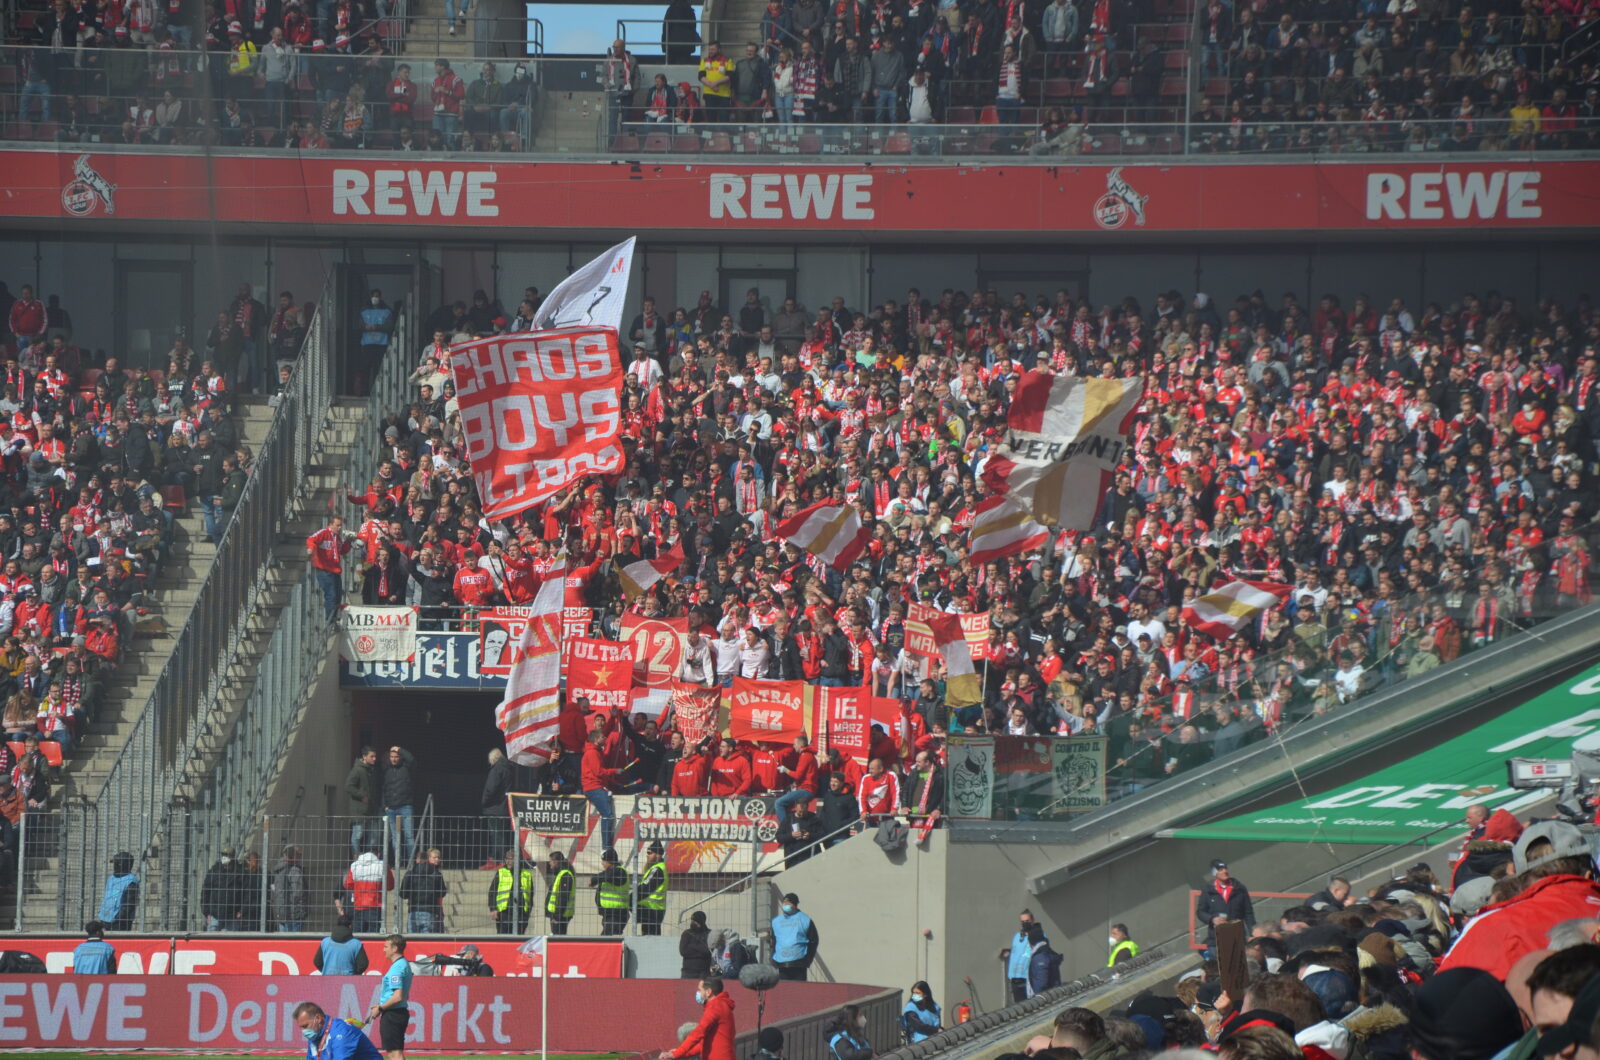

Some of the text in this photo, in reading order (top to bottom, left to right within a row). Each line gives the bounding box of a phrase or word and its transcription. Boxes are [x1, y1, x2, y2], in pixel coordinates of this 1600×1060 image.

[333, 169, 499, 217] REWE
[709, 173, 875, 220] REWE
[1366, 171, 1542, 220] REWE
[450, 334, 612, 397] CHAOS
[459, 387, 619, 463] BOYS
[346, 613, 411, 627] MBMM
[634, 628, 675, 674] 12
[572, 687, 628, 707] SZENE
[736, 689, 801, 711] ULTRAS
[834, 697, 864, 720] 16.
[751, 708, 784, 731] MZ
[833, 722, 864, 734] MÄRZ
[833, 735, 863, 747] 1905
[526, 799, 570, 811] CURVA
[637, 797, 742, 820] SEKTION
[517, 811, 581, 824] PARADISO
[638, 822, 755, 841] STADIONVERBOT
[336, 983, 512, 1044] Markt
